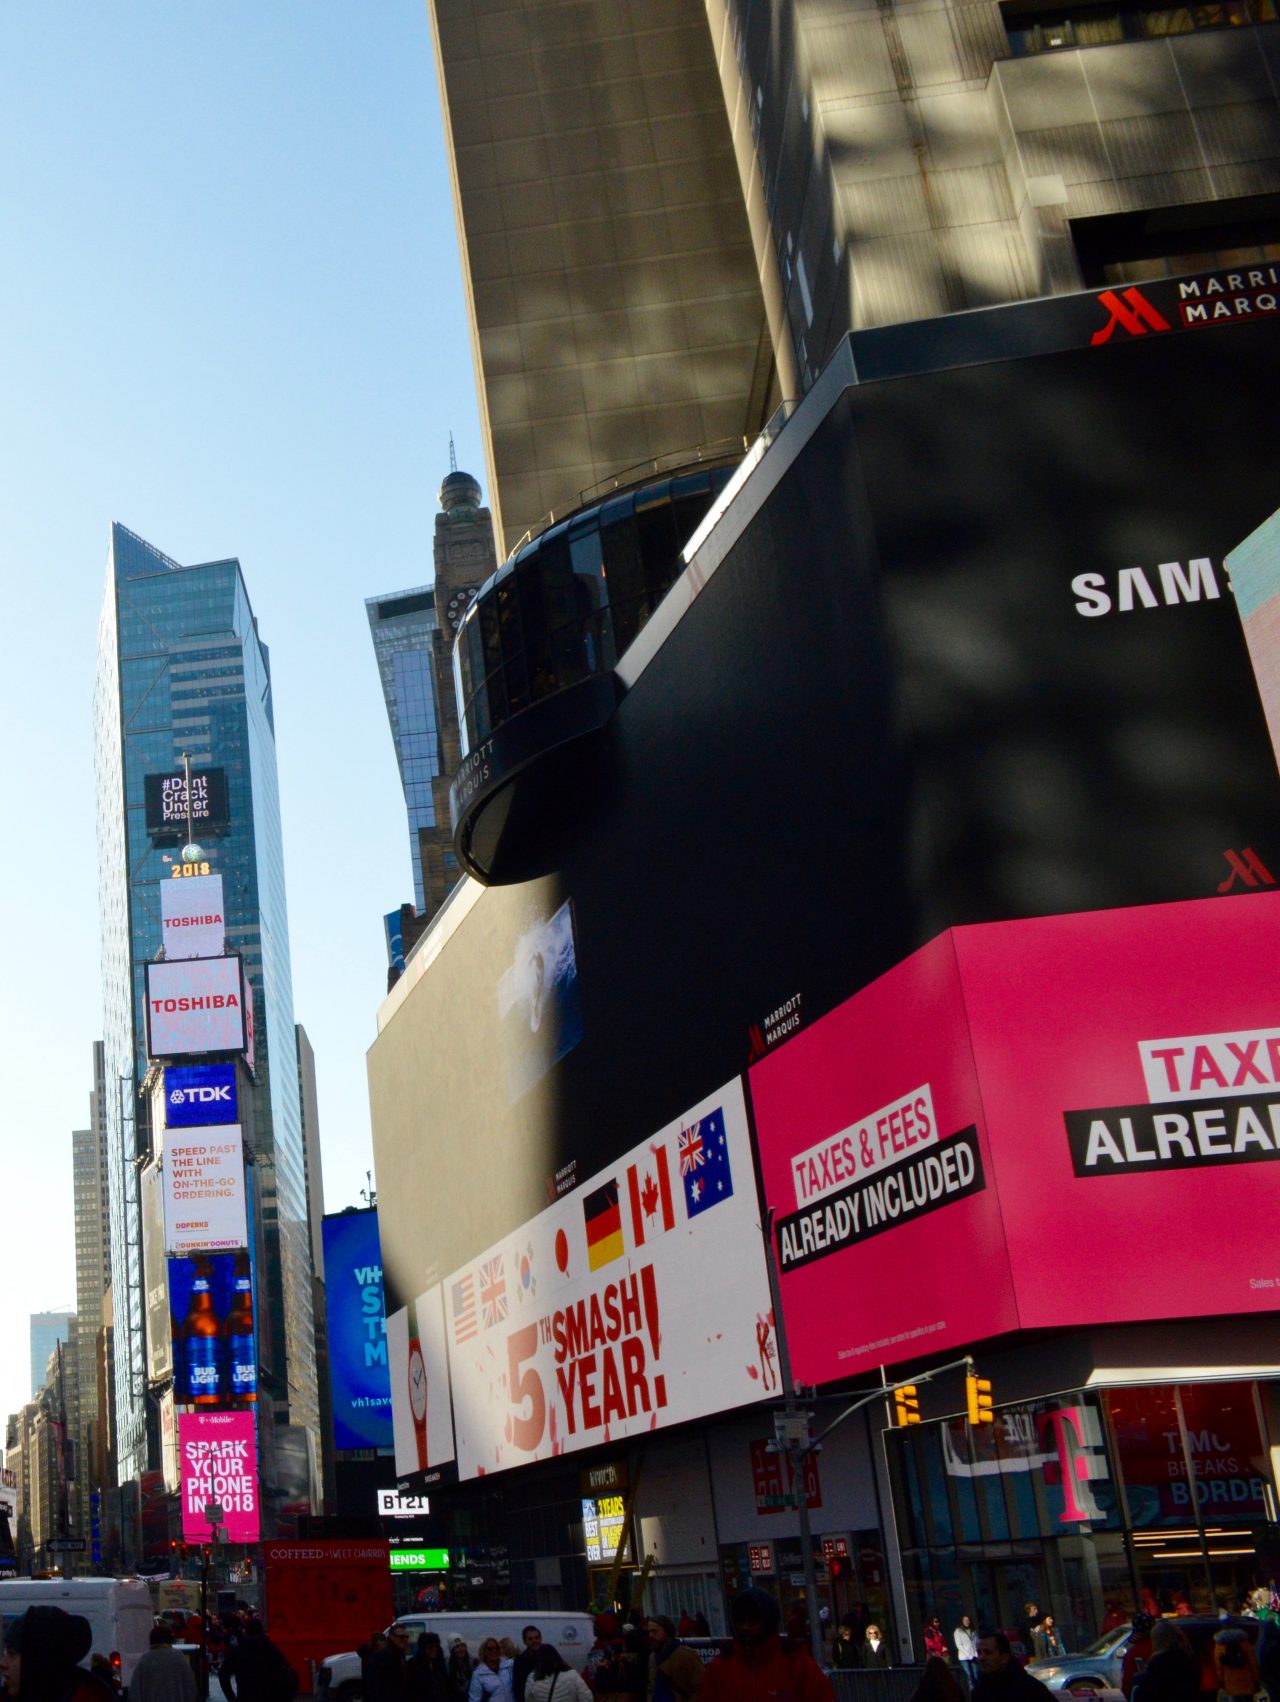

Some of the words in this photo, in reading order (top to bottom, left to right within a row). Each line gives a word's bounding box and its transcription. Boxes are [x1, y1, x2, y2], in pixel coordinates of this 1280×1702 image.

[1071, 556, 1234, 618] SAM
[162, 787, 208, 802] Crack
[172, 862, 211, 878] 2018
[163, 914, 222, 928] TOSHIBA
[152, 994, 239, 1013] TOSHIBA
[764, 993, 802, 1029] MARRIOTT
[766, 1013, 800, 1045] MARQUIS
[183, 1086, 231, 1103] TDK
[171, 1148, 206, 1156] SPEED
[210, 1145, 238, 1154] PAST
[796, 1137, 856, 1200] TAXES
[859, 1127, 875, 1169] &
[876, 1097, 932, 1160] FEES
[172, 1158, 193, 1167] THE
[196, 1157, 221, 1166] LINE
[172, 1169, 202, 1178] WITH
[173, 1177, 235, 1189] ON-THE-GO
[173, 1188, 234, 1200] ORDERING.
[781, 1191, 861, 1265] ALREADY
[863, 1141, 976, 1228] INCLUDED
[552, 1273, 642, 1364] SMASH
[190, 1374, 220, 1384] LIGHT
[193, 1366, 217, 1376] BUD
[185, 1440, 248, 1459] SPARK
[190, 1458, 244, 1477] YOUR
[1167, 1457, 1239, 1477] BREAKS
[187, 1476, 253, 1495] PHONE
[188, 1496, 207, 1514] IN
[383, 1495, 424, 1509] BT21
[270, 1549, 324, 1560] COFFEED
[329, 1547, 352, 1560] SWEET
